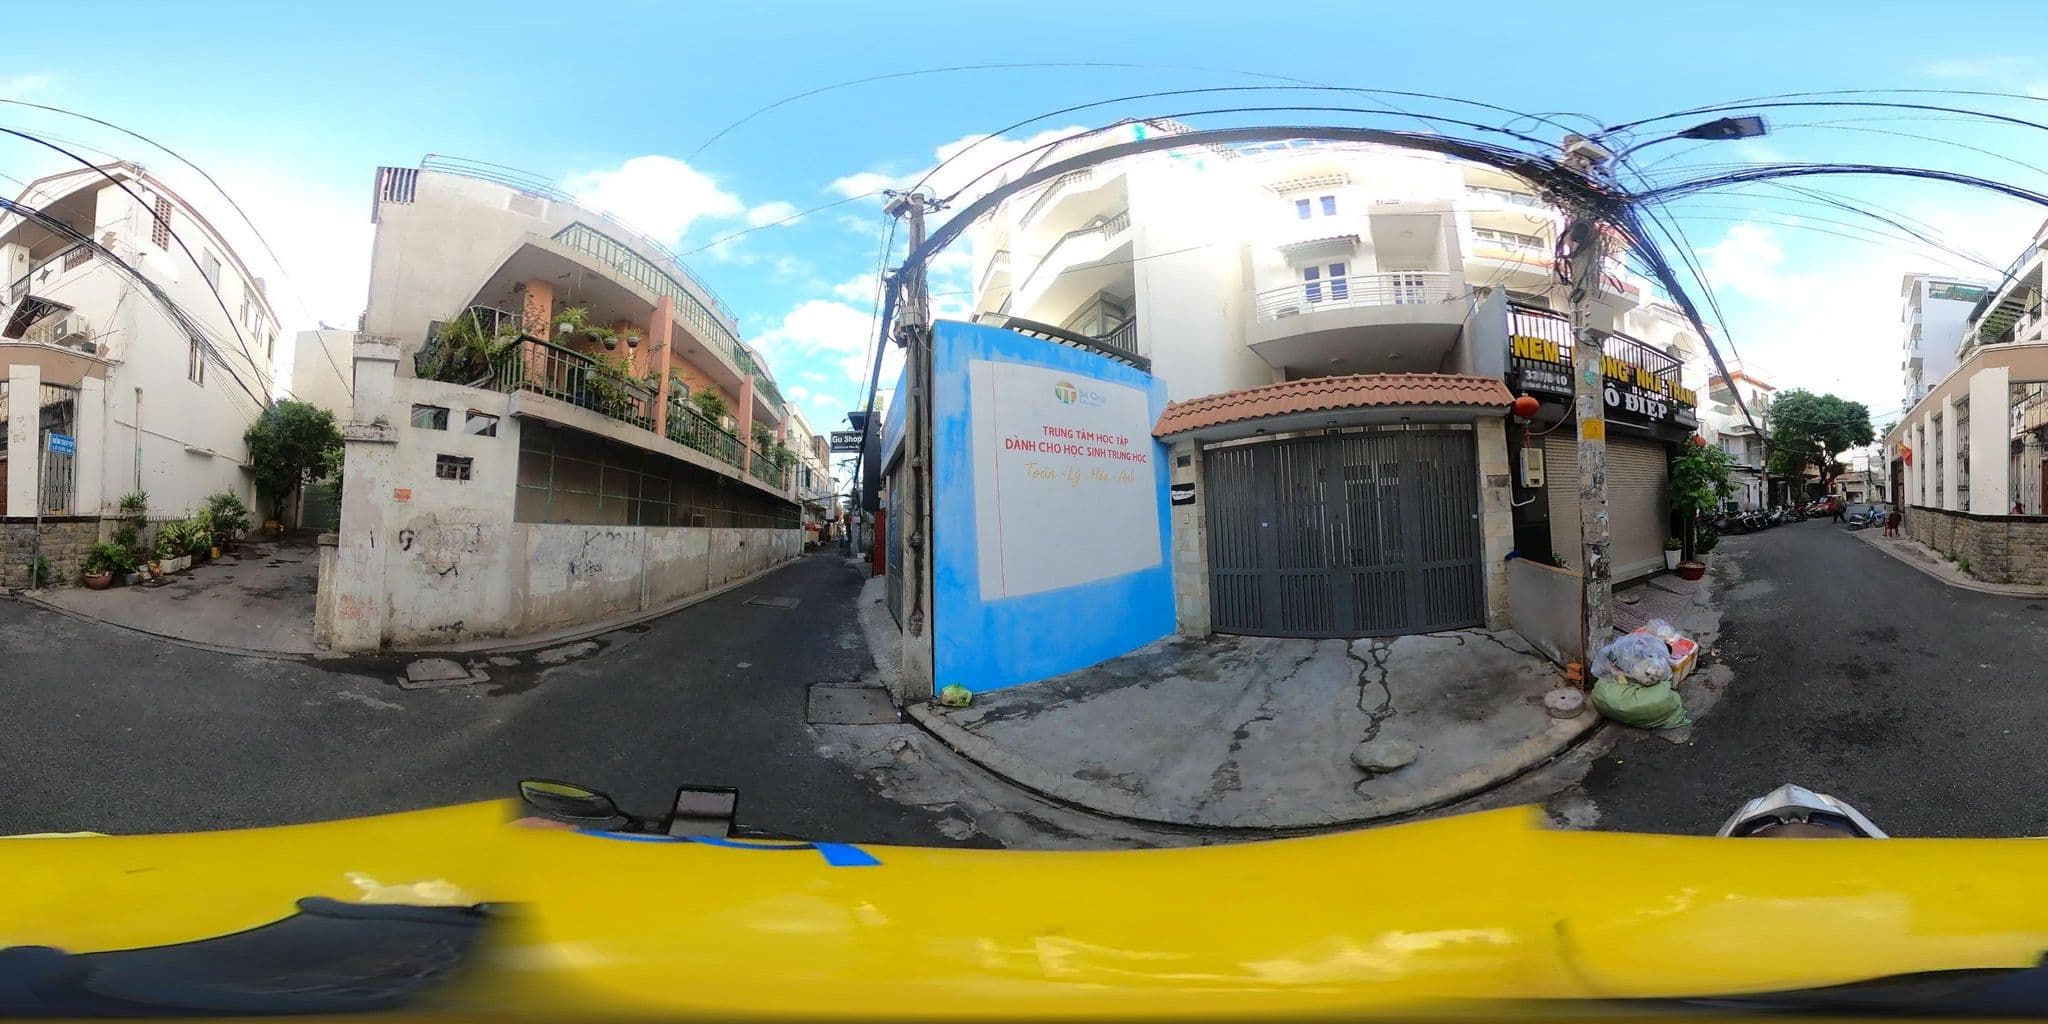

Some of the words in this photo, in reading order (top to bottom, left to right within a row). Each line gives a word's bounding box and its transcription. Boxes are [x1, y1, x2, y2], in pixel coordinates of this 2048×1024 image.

[1513, 335, 1560, 364] NEM
[1637, 368, 1661, 394] NHA
[1624, 393, 1668, 422] ĐIỆP
[832, 435, 843, 443] Gu
[844, 435, 862, 445] Shop
[1005, 434, 1036, 452] DÀNH
[1038, 441, 1062, 454] CHO
[1063, 444, 1084, 458] HỌC
[1086, 446, 1106, 458] SINH
[1107, 449, 1132, 461] TRUNG
[1132, 452, 1147, 465] HỌC
[1042, 425, 1074, 439] TRUNG
[1075, 428, 1094, 441] TÂM
[1096, 433, 1114, 446] HỌC
